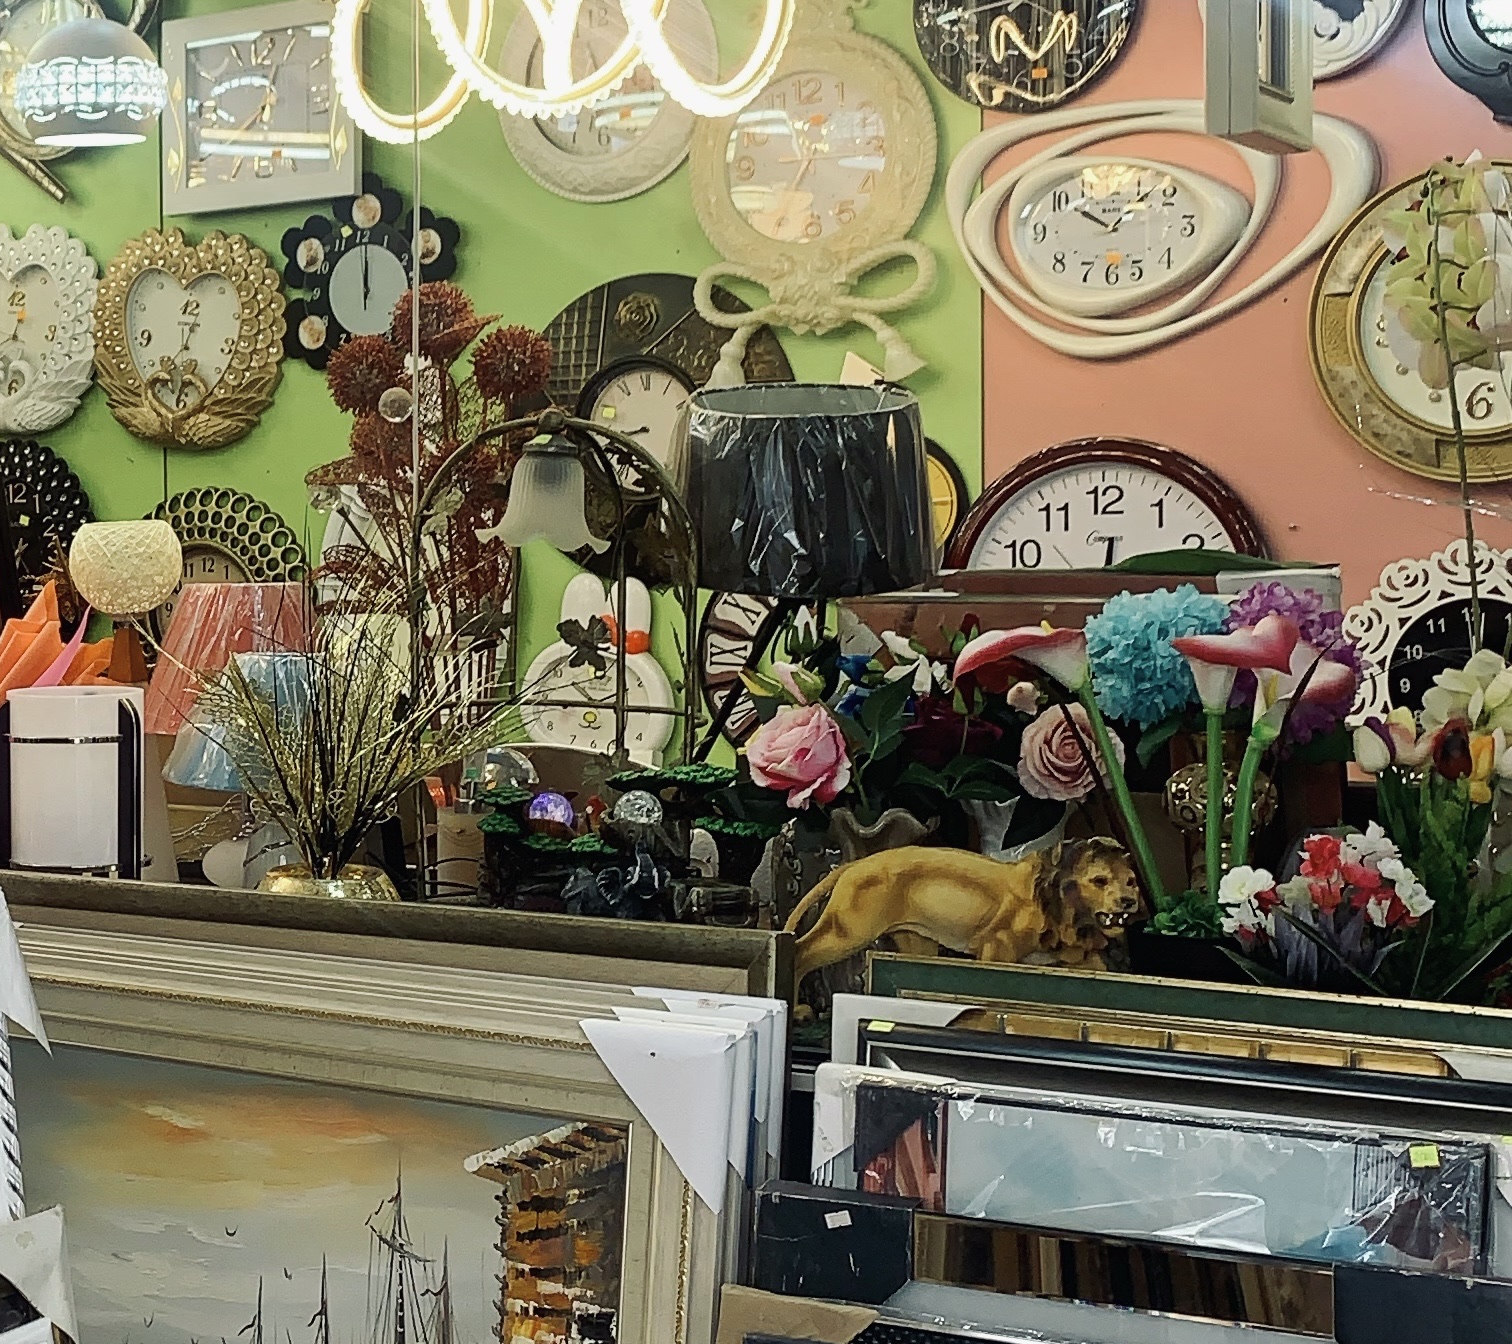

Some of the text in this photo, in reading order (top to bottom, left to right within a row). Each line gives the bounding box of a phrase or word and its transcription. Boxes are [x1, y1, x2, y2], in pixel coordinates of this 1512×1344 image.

[765, 92, 786, 110] 11
[792, 78, 822, 104] 12
[835, 81, 844, 106] 1
[598, 127, 610, 146] 6
[736, 156, 755, 181] 9
[857, 171, 875, 194] 4
[1053, 191, 1069, 212] 10
[1162, 185, 1177, 207] 2
[837, 200, 856, 224] 5
[804, 213, 822, 238] 6
[1033, 222, 1046, 244] 9
[1180, 215, 1195, 238] 3
[335, 238, 346, 251] 11
[356, 231, 370, 243] 12
[317, 261, 329, 275] 10
[1052, 251, 1066, 273] 8
[1158, 247, 1174, 270] 4
[1081, 261, 1094, 283] 7
[1105, 264, 1119, 285] 6
[1130, 260, 1143, 281] 5
[8, 291, 26, 307] 12
[180, 299, 200, 315] 12
[139, 329, 152, 347] 9
[220, 337, 235, 355] 3
[1466, 382, 1496, 420] 6
[7, 482, 27, 504] 12
[33, 493, 40, 514] 1
[1086, 485, 1124, 516] 12
[1038, 502, 1069, 532] 11
[1150, 497, 1164, 528] 1
[42, 516, 55, 537] 2
[1004, 539, 1042, 568] 10
[183, 562, 194, 578] 11
[201, 557, 215, 573] 12
[223, 564, 229, 580] 1
[165, 603, 173, 618] 9
[1427, 618, 1445, 633] 11
[1404, 645, 1422, 660] 10
[1400, 678, 1410, 693] 9
[547, 721, 554, 731] 8
[570, 735, 577, 745] 7
[590, 739, 597, 749] 6
[636, 732, 643, 742] 4
